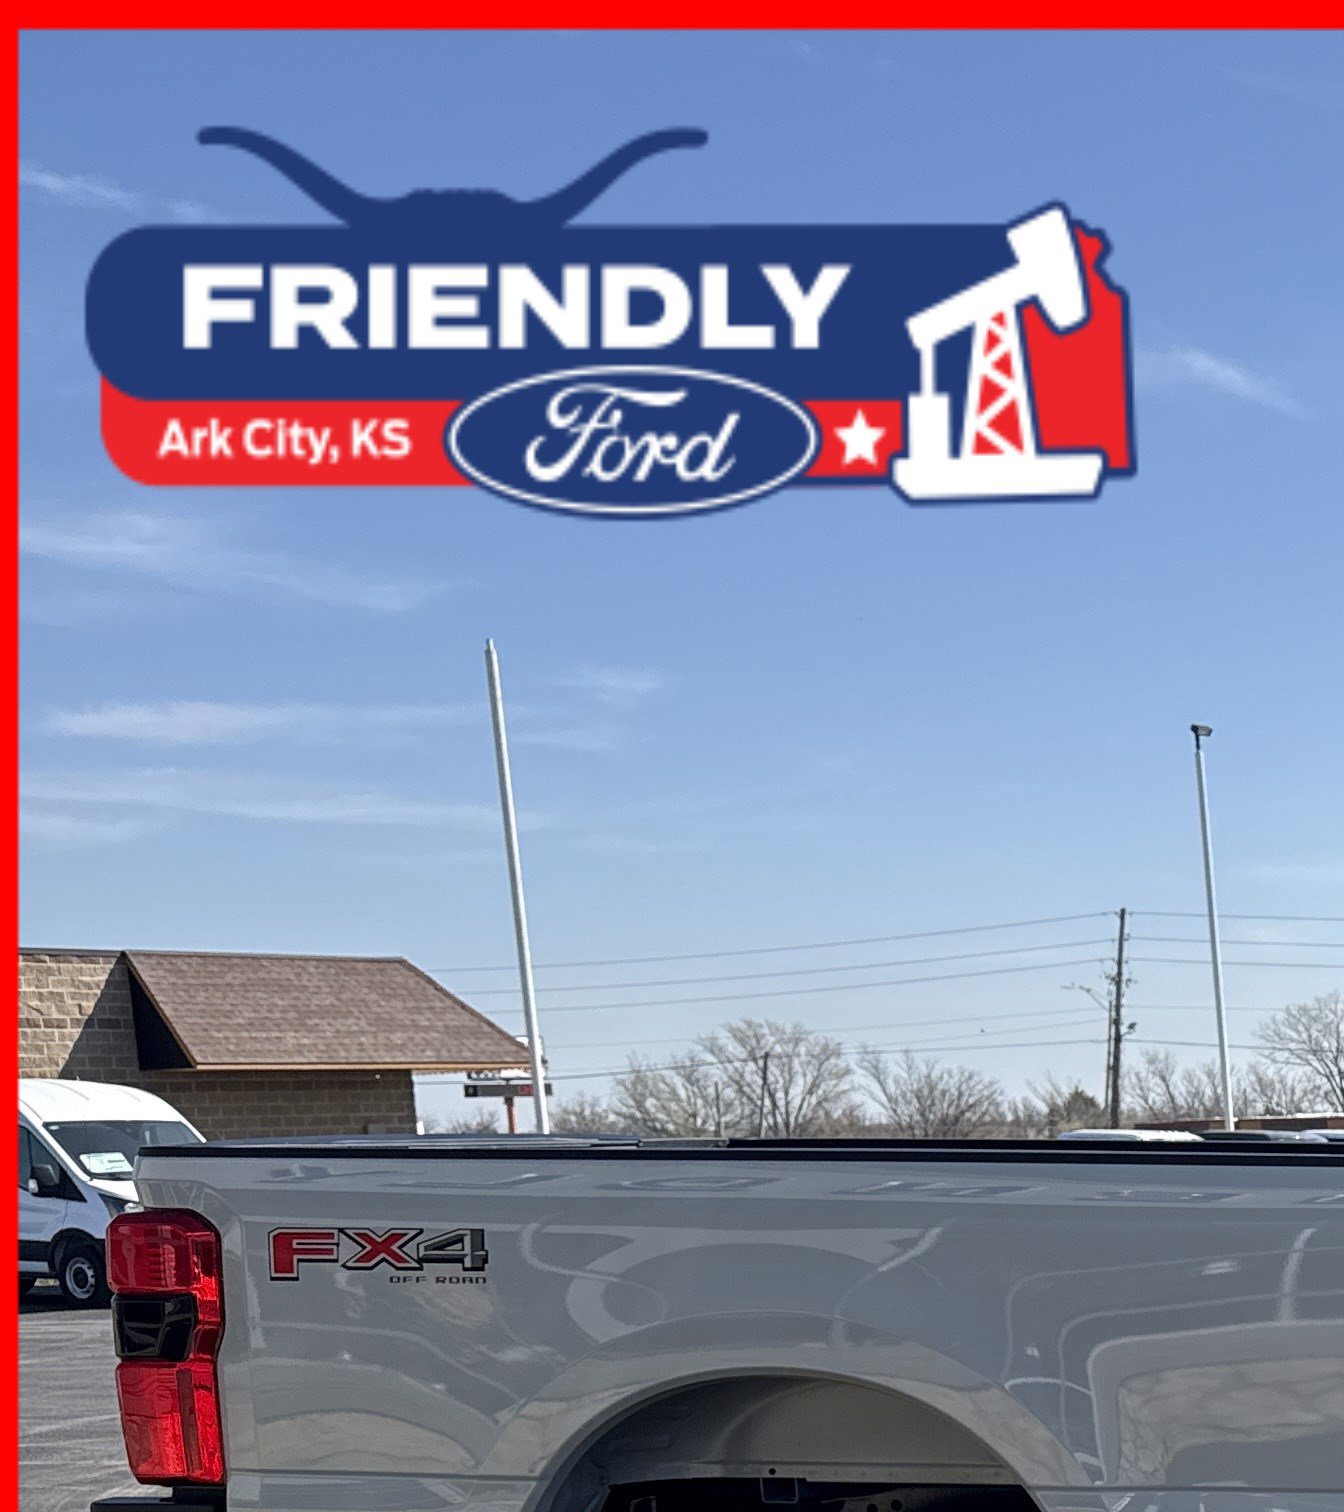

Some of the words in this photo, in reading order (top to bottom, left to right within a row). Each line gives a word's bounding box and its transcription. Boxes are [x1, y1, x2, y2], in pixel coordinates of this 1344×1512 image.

[268, 1227, 488, 1281] FX4
[389, 1275, 427, 1284] OFF
[435, 1275, 487, 1284] ROAD
